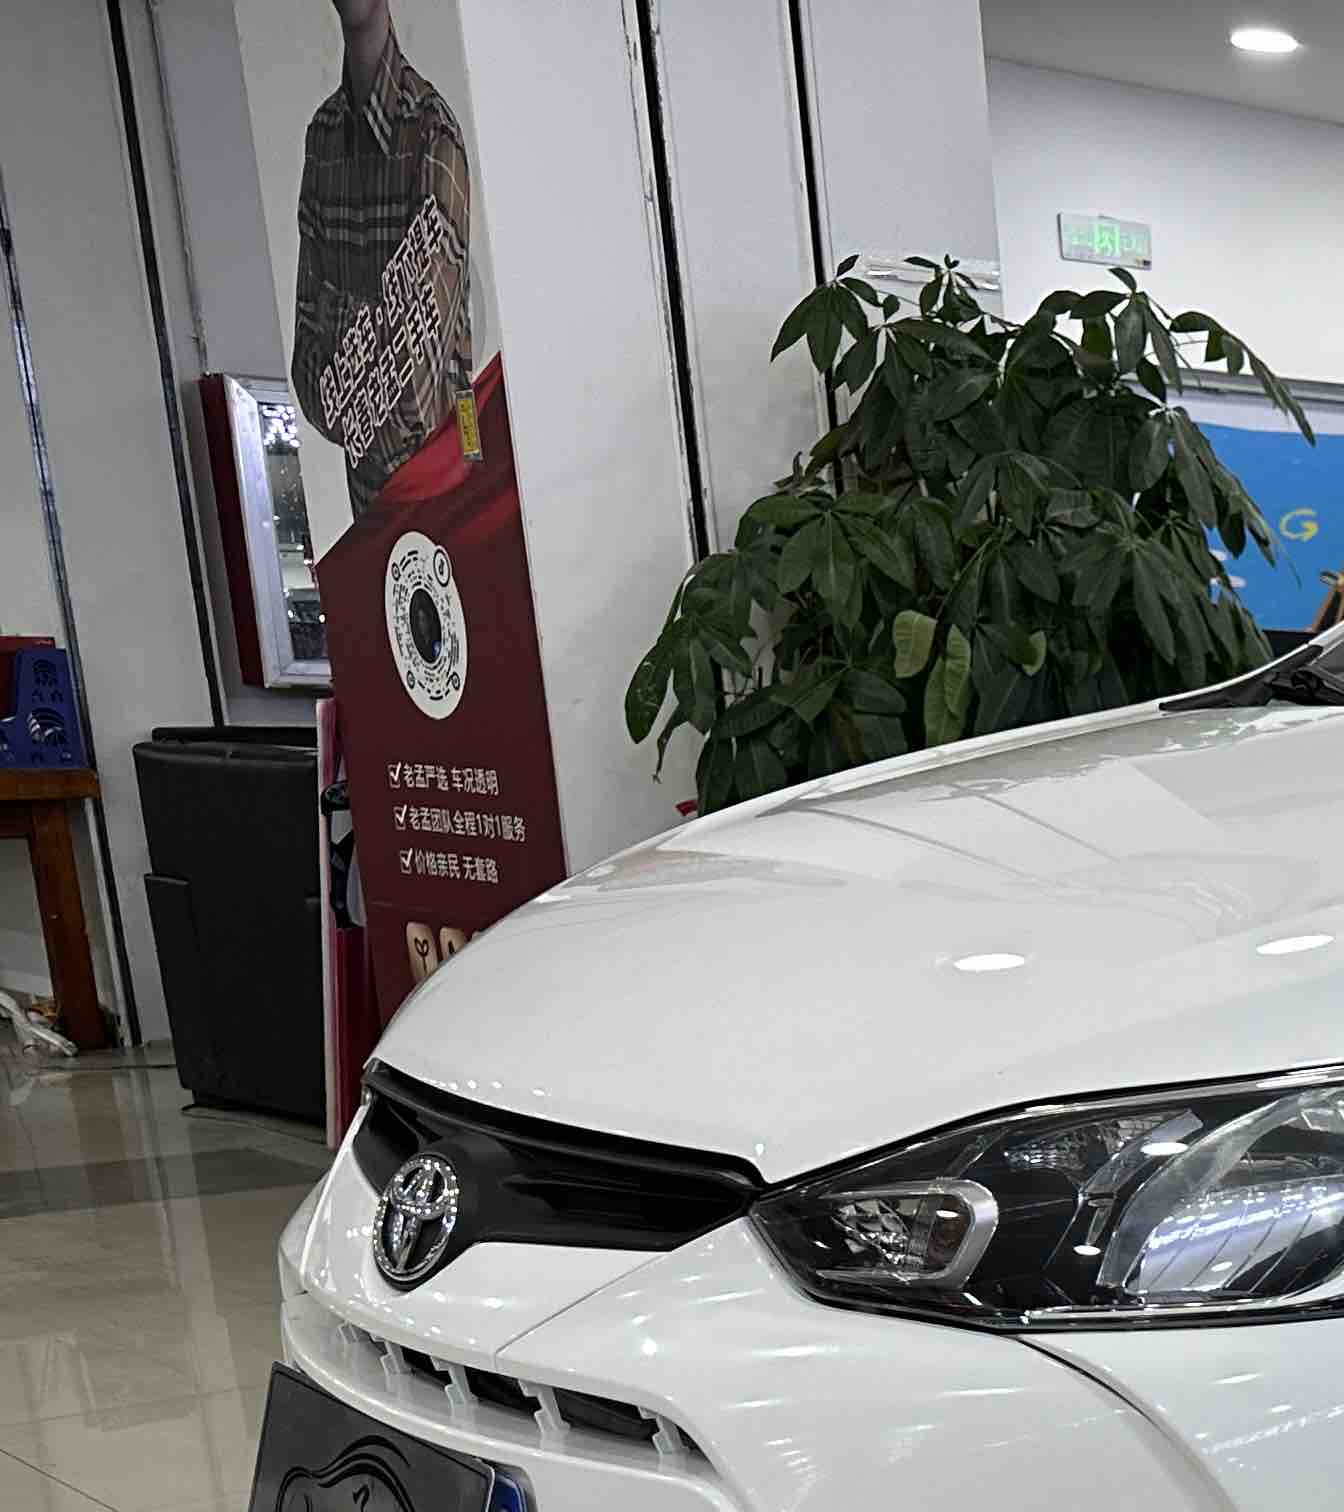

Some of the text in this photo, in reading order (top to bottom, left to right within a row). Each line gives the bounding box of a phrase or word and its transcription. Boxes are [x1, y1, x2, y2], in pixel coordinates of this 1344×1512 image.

[403, 763, 499, 795] 老孟严选 车况透明
[409, 806, 526, 842] 老孟团队全程1对1服务
[415, 850, 498, 883] 价格亲民 无套路
